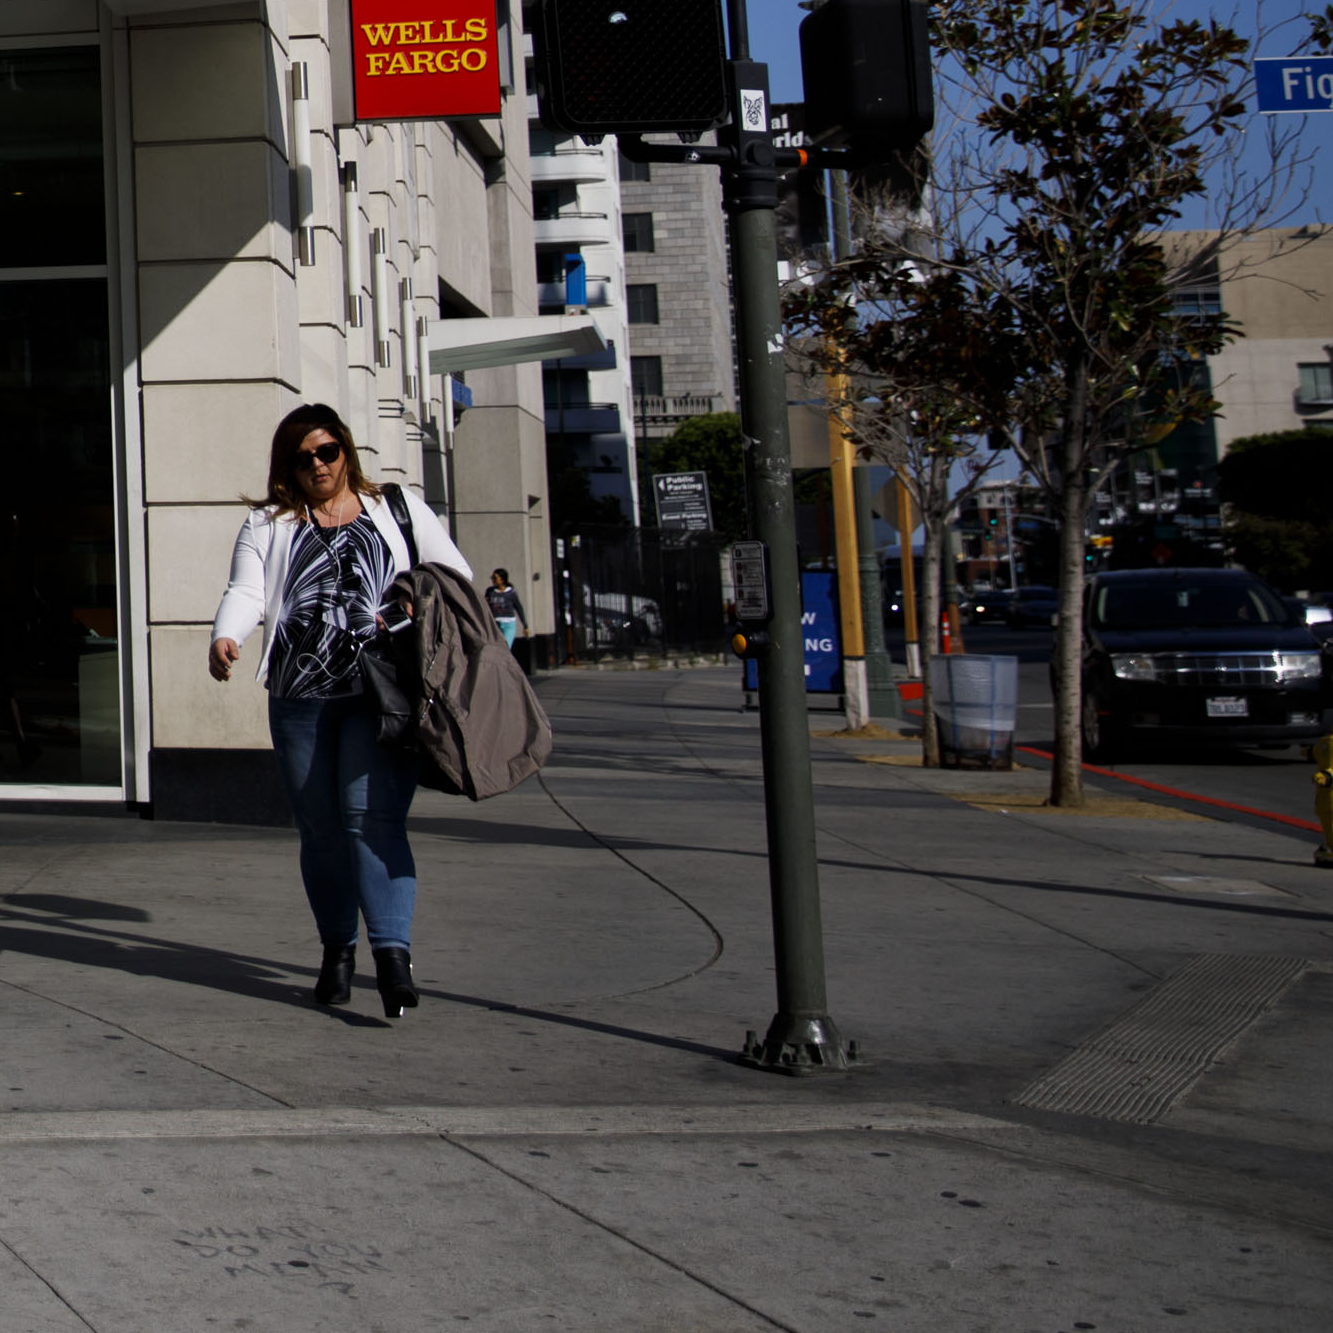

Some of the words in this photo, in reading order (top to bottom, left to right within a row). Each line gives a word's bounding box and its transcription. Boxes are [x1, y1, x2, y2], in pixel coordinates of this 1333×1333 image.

[360, 17, 489, 47] WELLS
[365, 47, 488, 77] FARGO
[666, 476, 696, 486] Public
[667, 482, 703, 491] Parking
